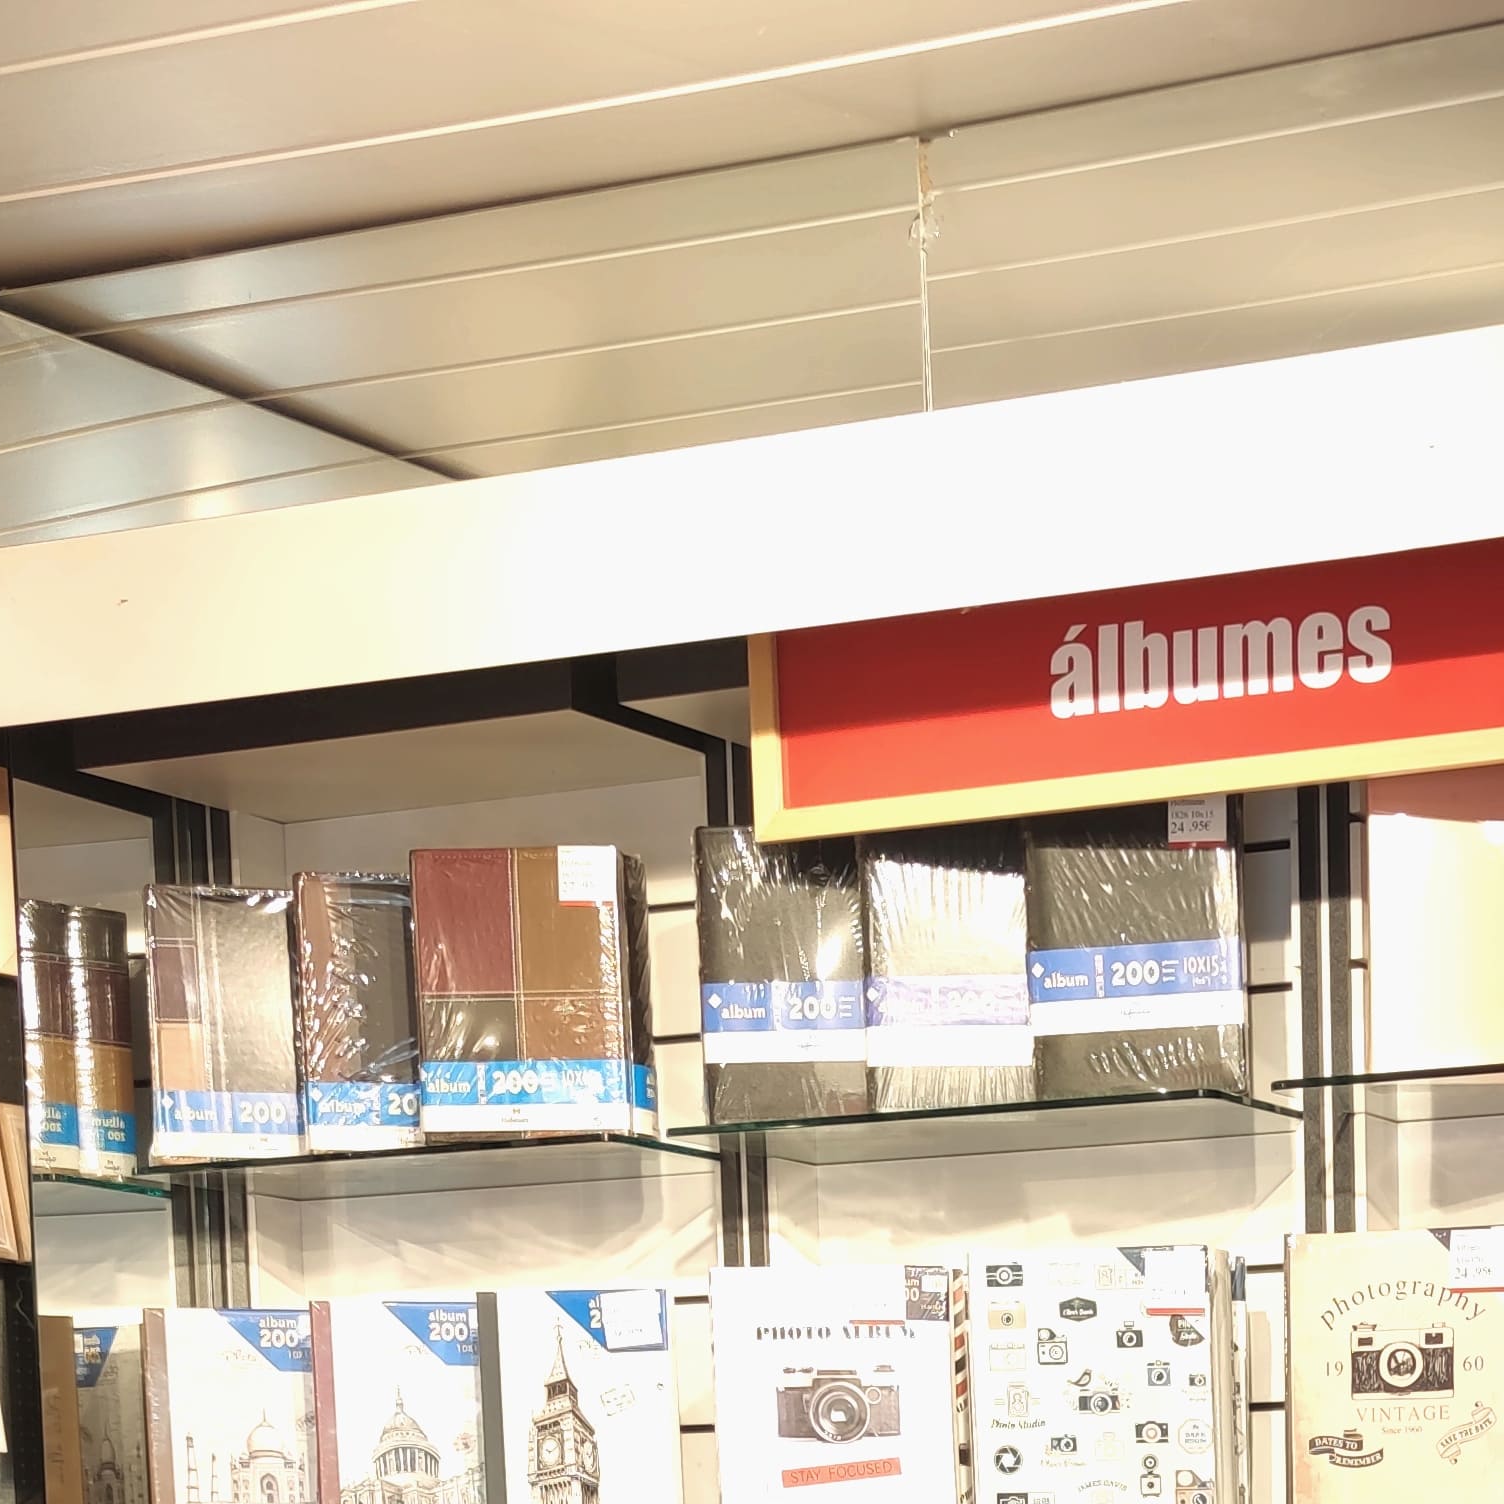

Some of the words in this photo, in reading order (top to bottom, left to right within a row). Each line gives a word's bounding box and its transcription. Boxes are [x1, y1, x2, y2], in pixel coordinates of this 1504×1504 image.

[1049, 603, 1393, 720] álbumes
[1356, 1404, 1450, 1423] VINTAGE
[790, 1467, 821, 1484] STAY
[827, 1460, 892, 1478] FOCUSED
